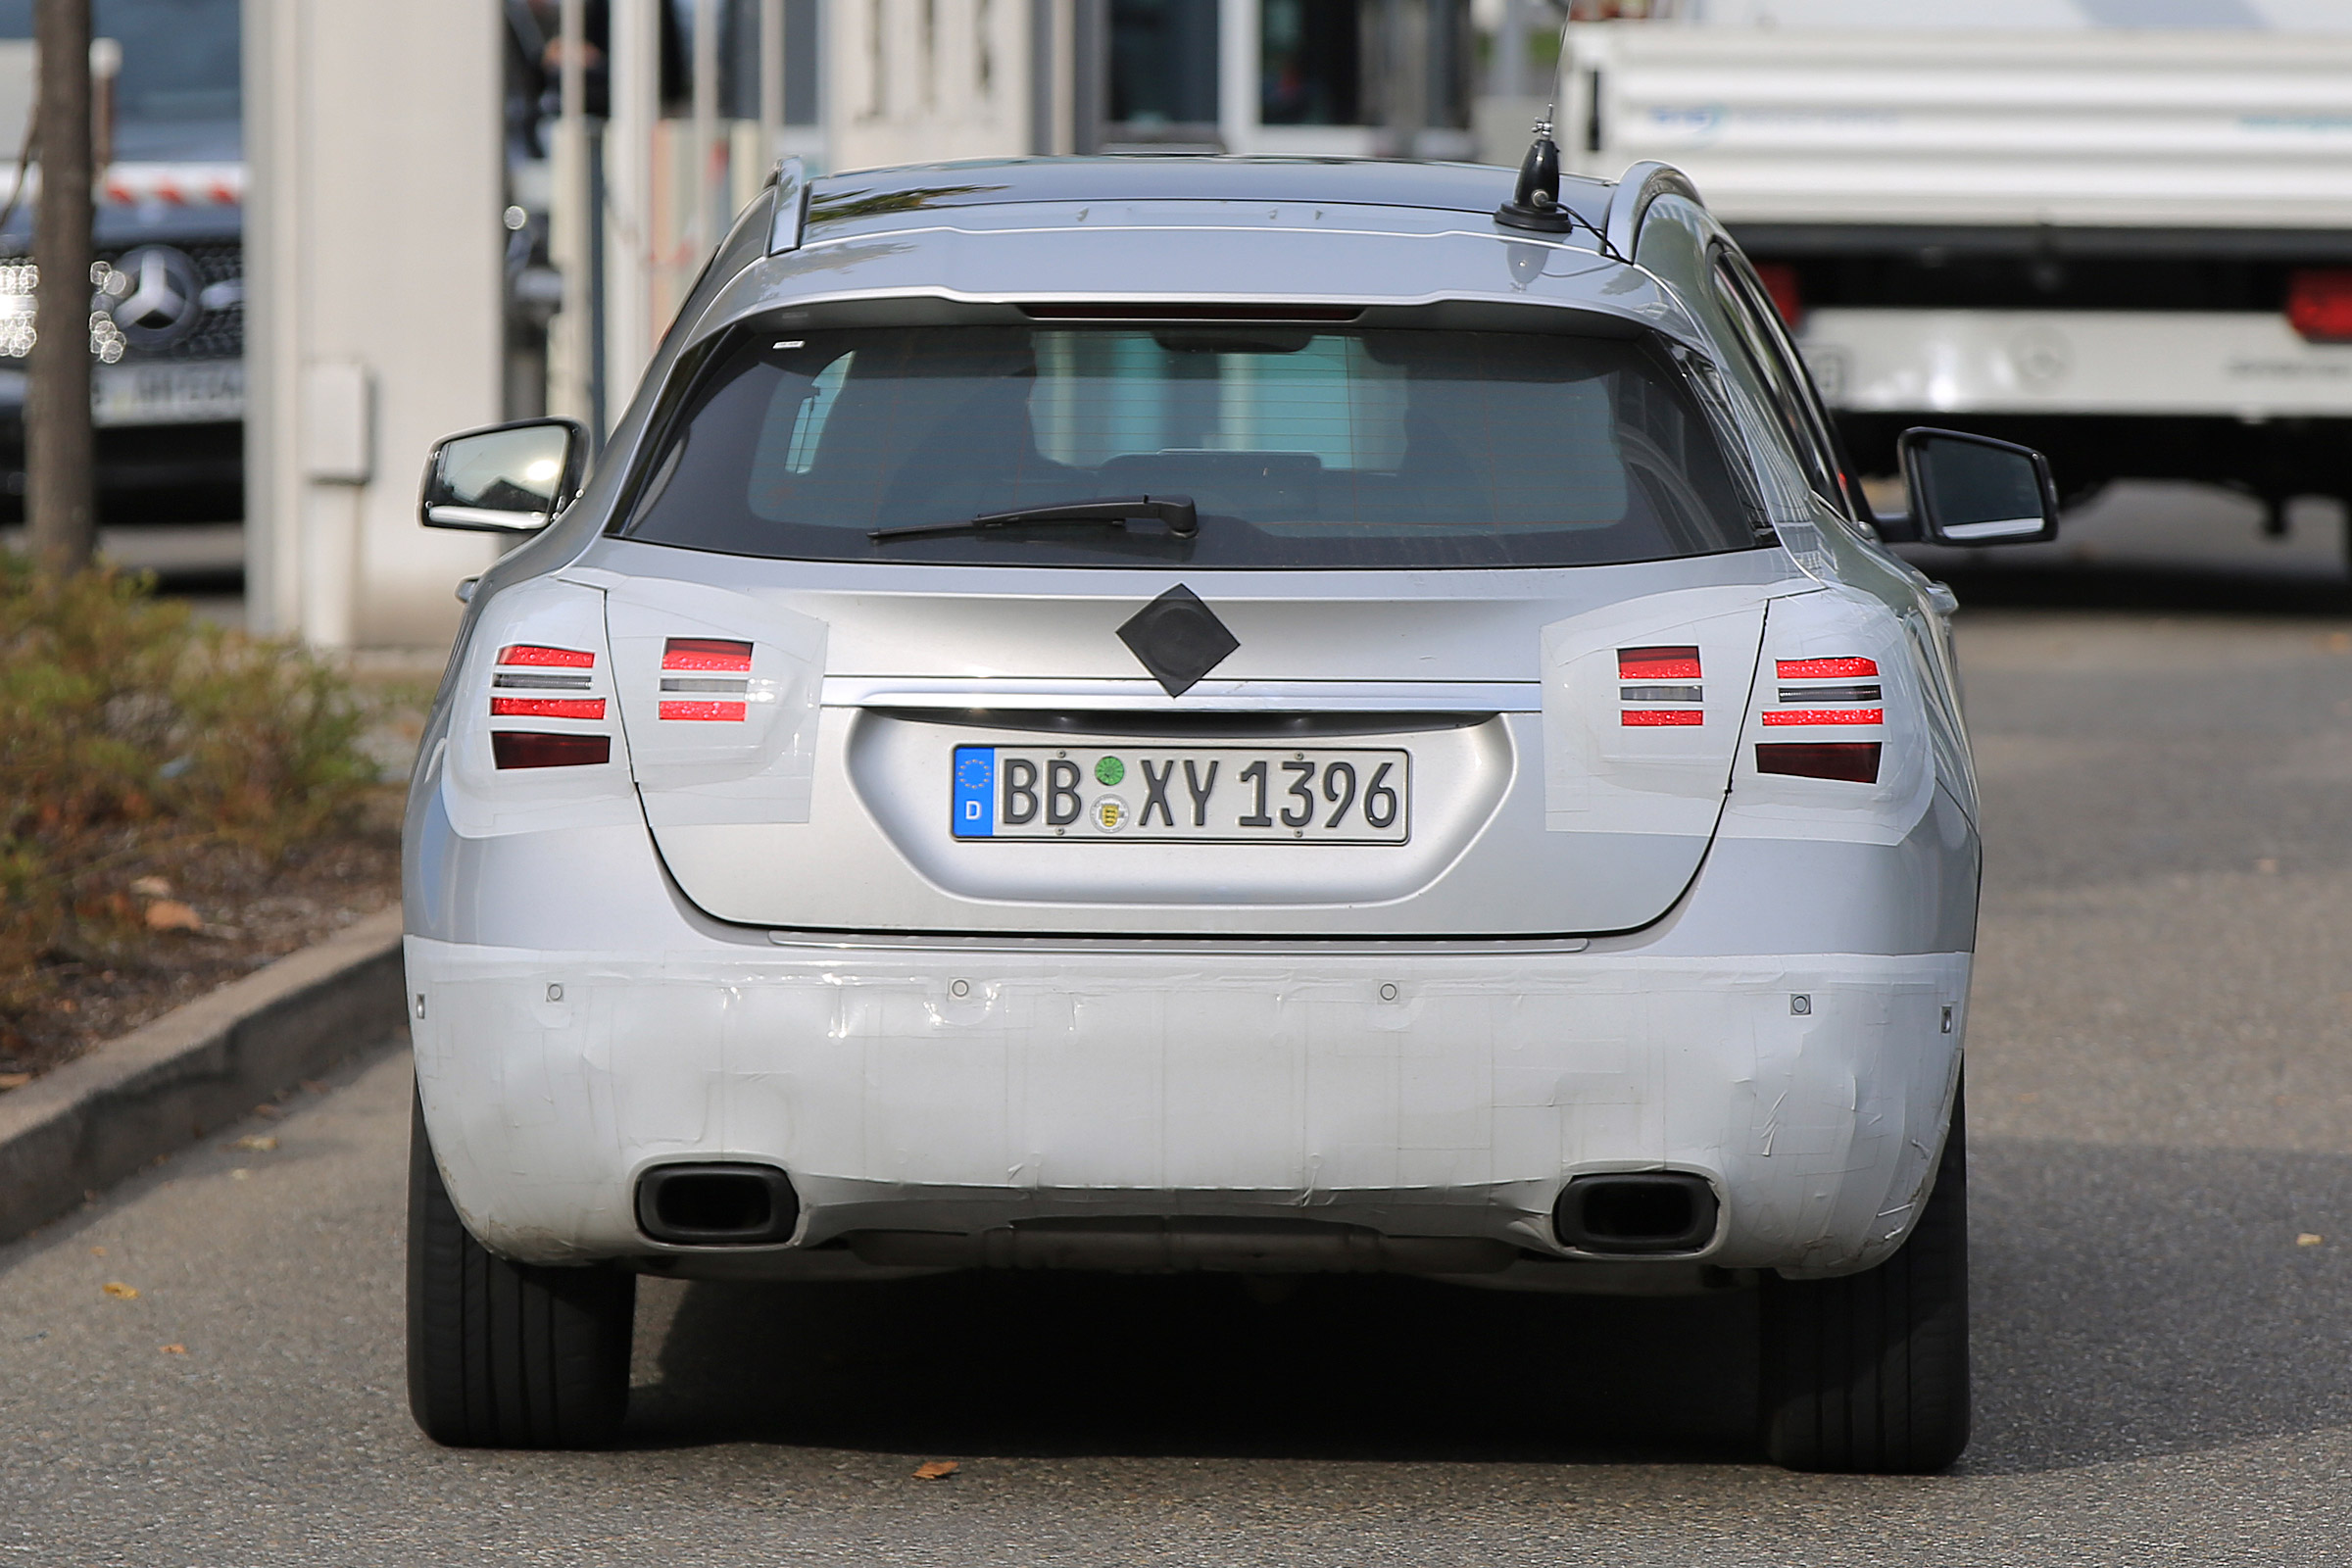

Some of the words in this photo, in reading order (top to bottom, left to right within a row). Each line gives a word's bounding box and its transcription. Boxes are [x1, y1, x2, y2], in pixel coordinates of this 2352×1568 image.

[965, 800, 982, 820] D
[1003, 758, 1082, 826] BB
[1138, 760, 1220, 827] XY
[1239, 760, 1398, 830] 1396
